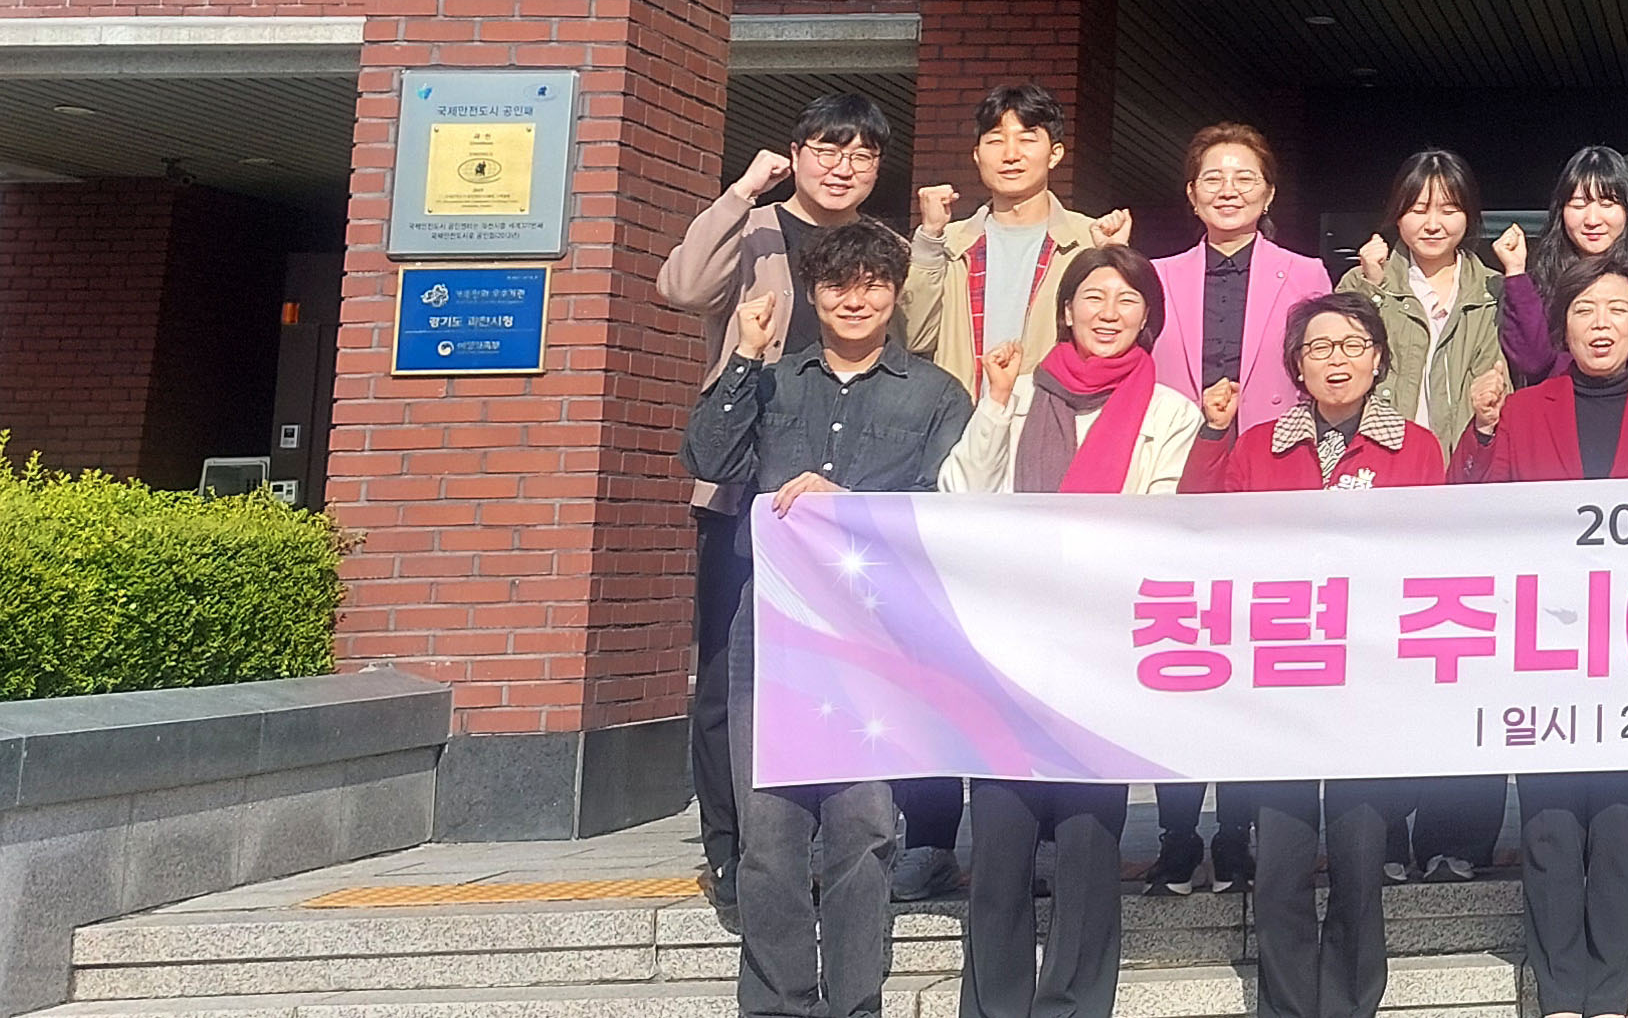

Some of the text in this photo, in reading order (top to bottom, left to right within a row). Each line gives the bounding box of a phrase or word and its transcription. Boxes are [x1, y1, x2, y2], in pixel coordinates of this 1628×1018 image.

[437, 105, 499, 117] 국제안전도시
[1131, 577, 1350, 692] 청렴
[1501, 703, 1578, 746] 일시
